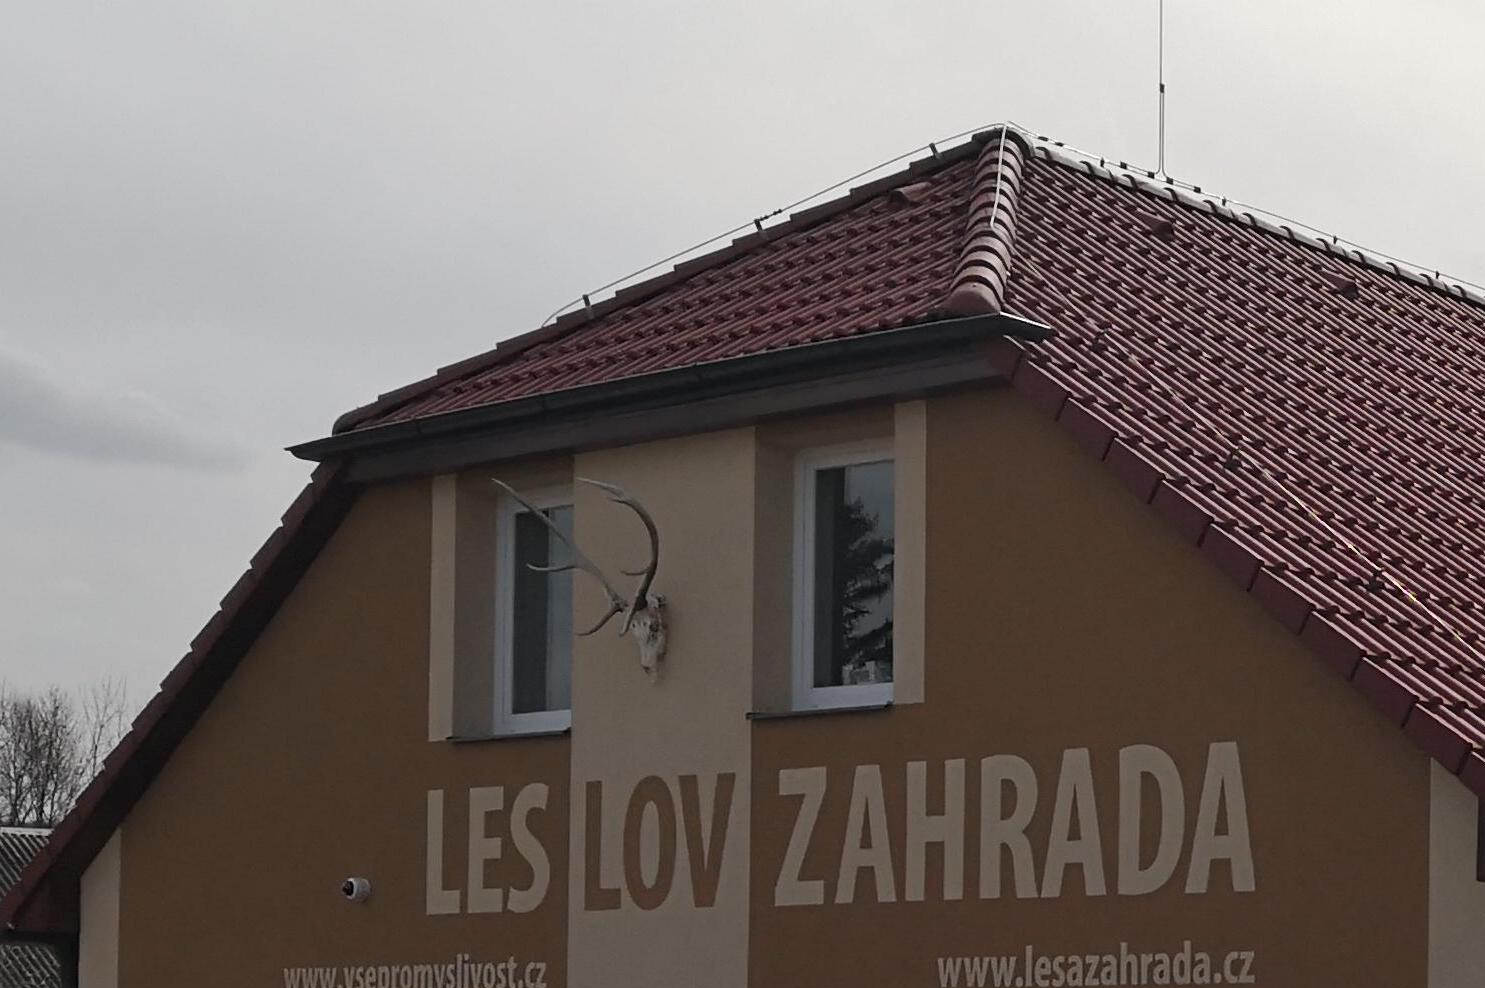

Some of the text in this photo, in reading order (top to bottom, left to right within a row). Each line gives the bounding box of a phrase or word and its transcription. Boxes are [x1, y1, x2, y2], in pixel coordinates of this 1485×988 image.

[426, 741, 1256, 915] LES LOV ZAHRADA
[937, 940, 1256, 988] www.lesazahrada.cz
